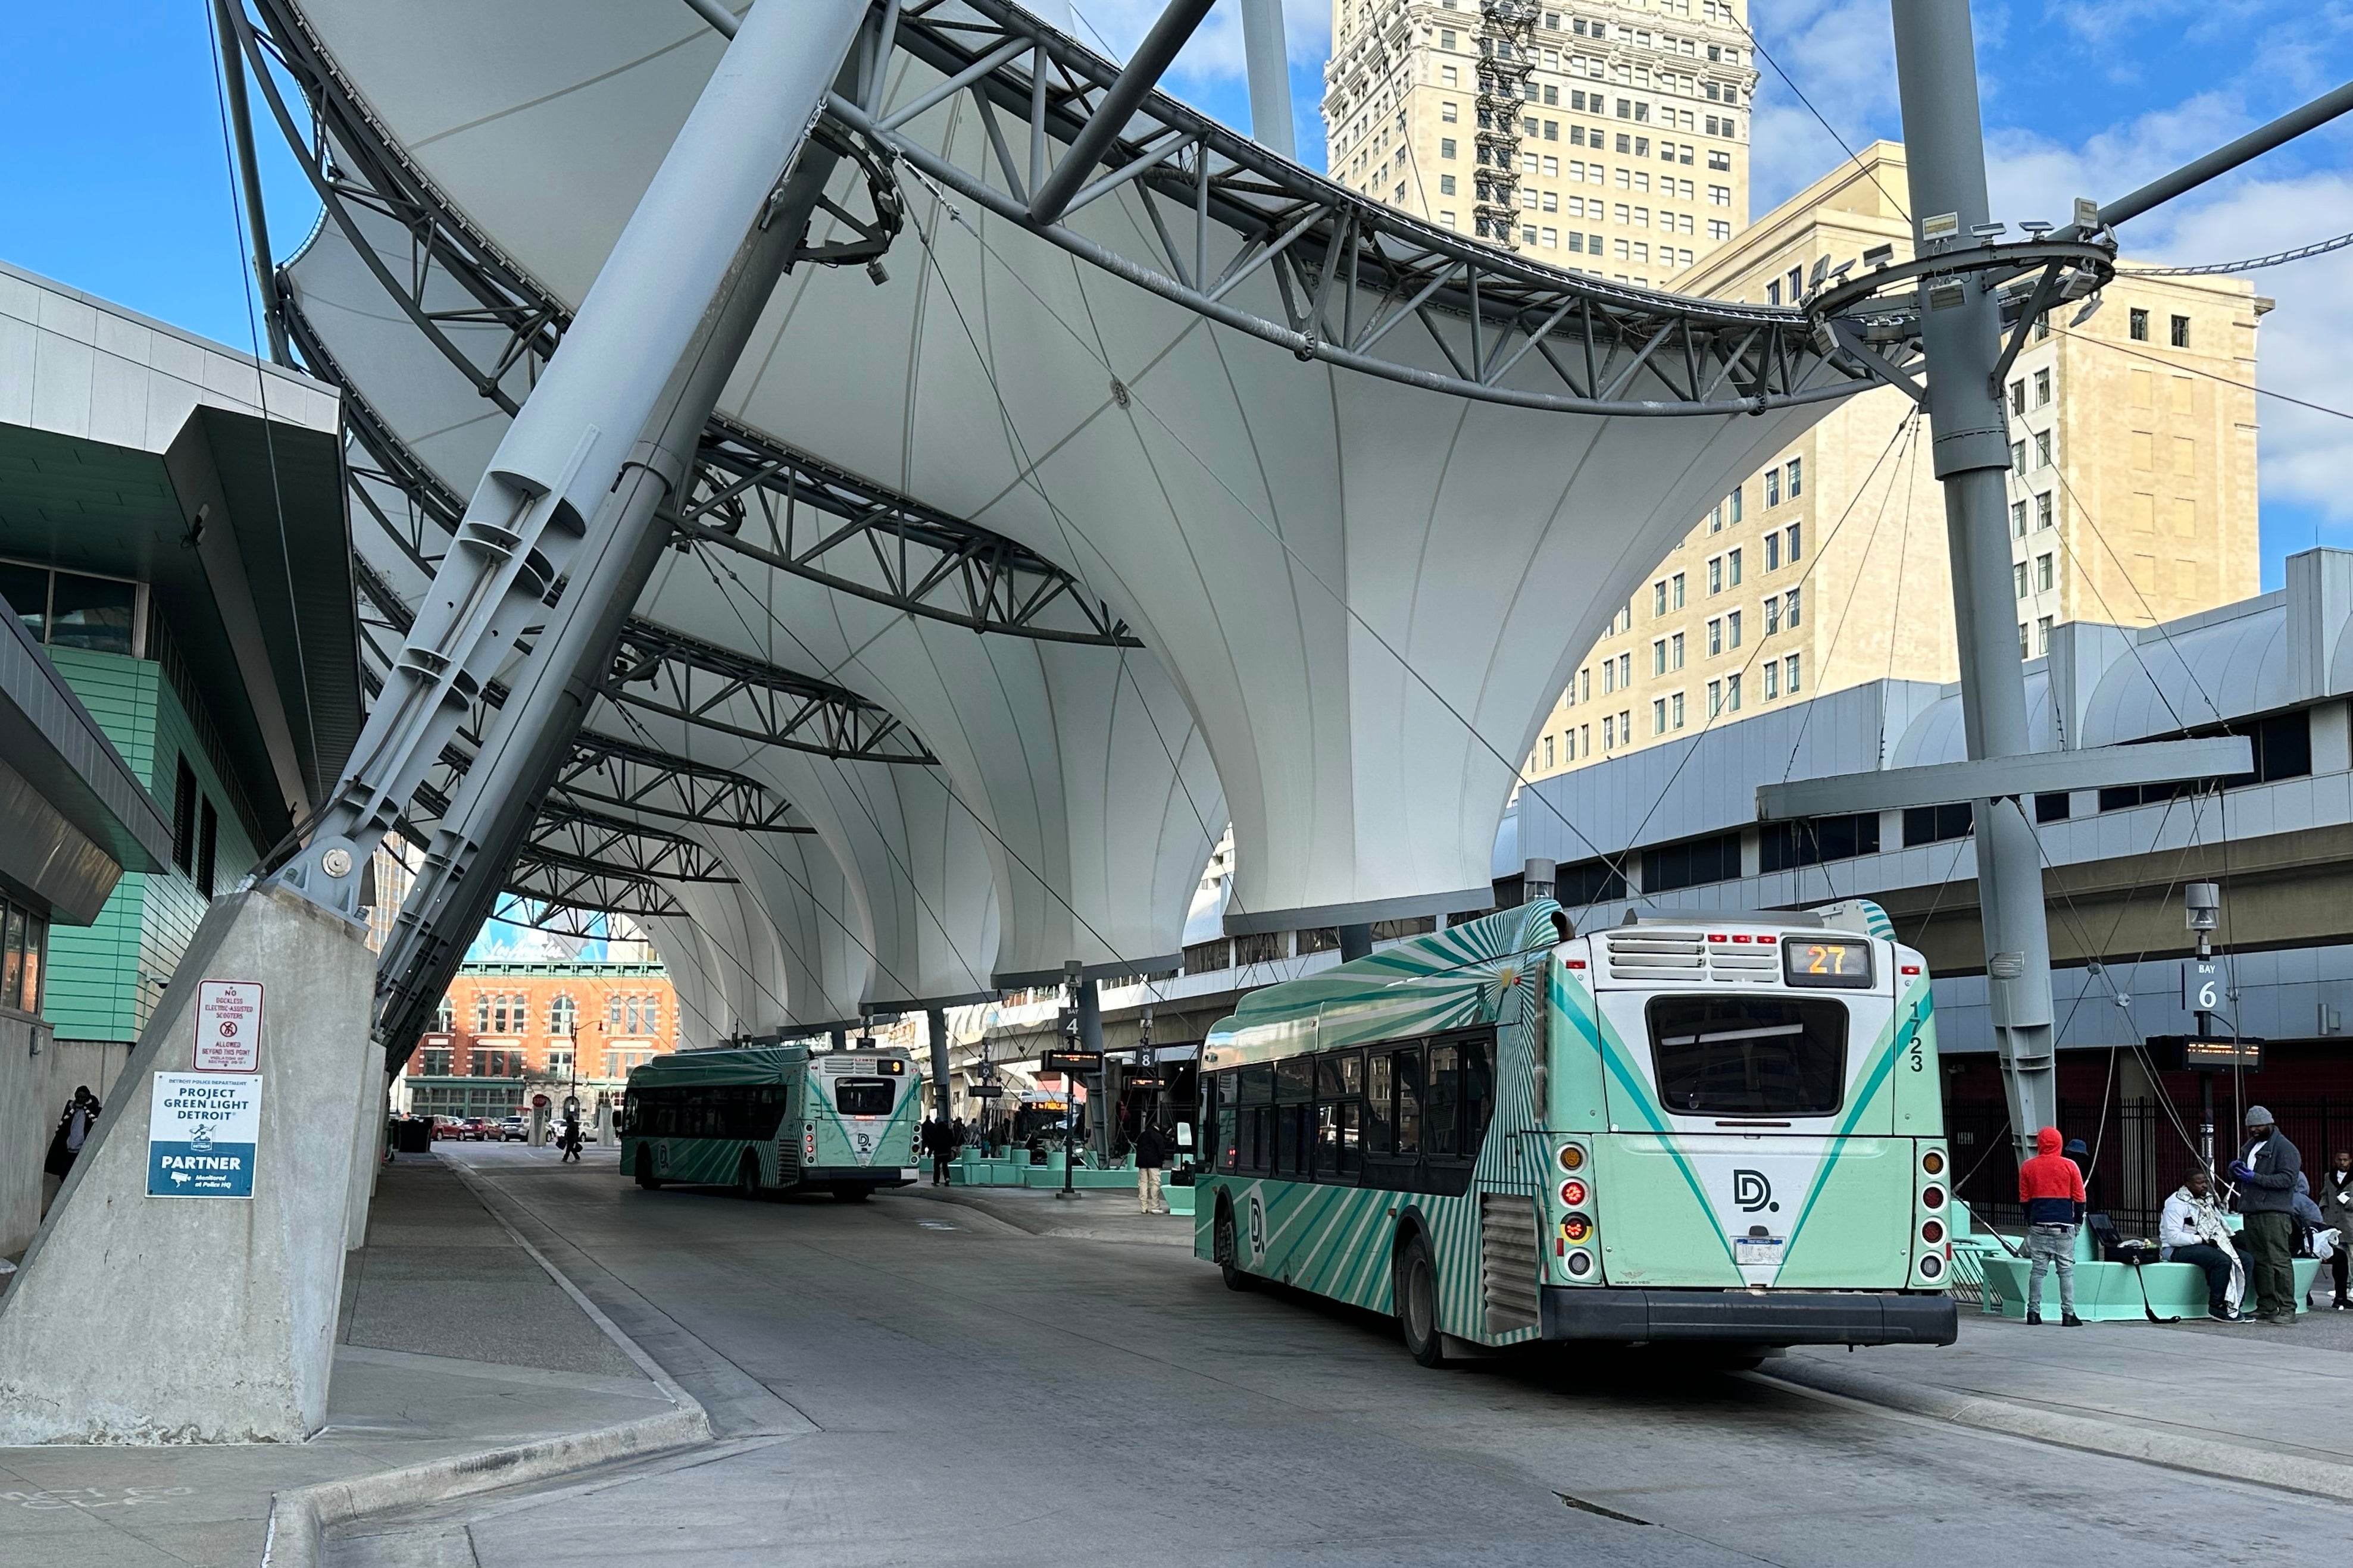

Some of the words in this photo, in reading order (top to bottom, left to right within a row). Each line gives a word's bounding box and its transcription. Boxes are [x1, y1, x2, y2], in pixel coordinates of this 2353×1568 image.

[1808, 946, 1846, 974] 27
[2198, 965, 2215, 974] BAY
[2199, 981, 2217, 1008] 6
[1065, 1018, 1079, 1034] 4
[1910, 1001, 1923, 1072] 1723
[1142, 1054, 1151, 1066] 8
[893, 1062, 900, 1072] 9
[179, 1088, 236, 1099] PROJECT
[164, 1099, 206, 1109] GREEN
[210, 1100, 249, 1110] LIGHT
[161, 1156, 240, 1170] PARTNER
